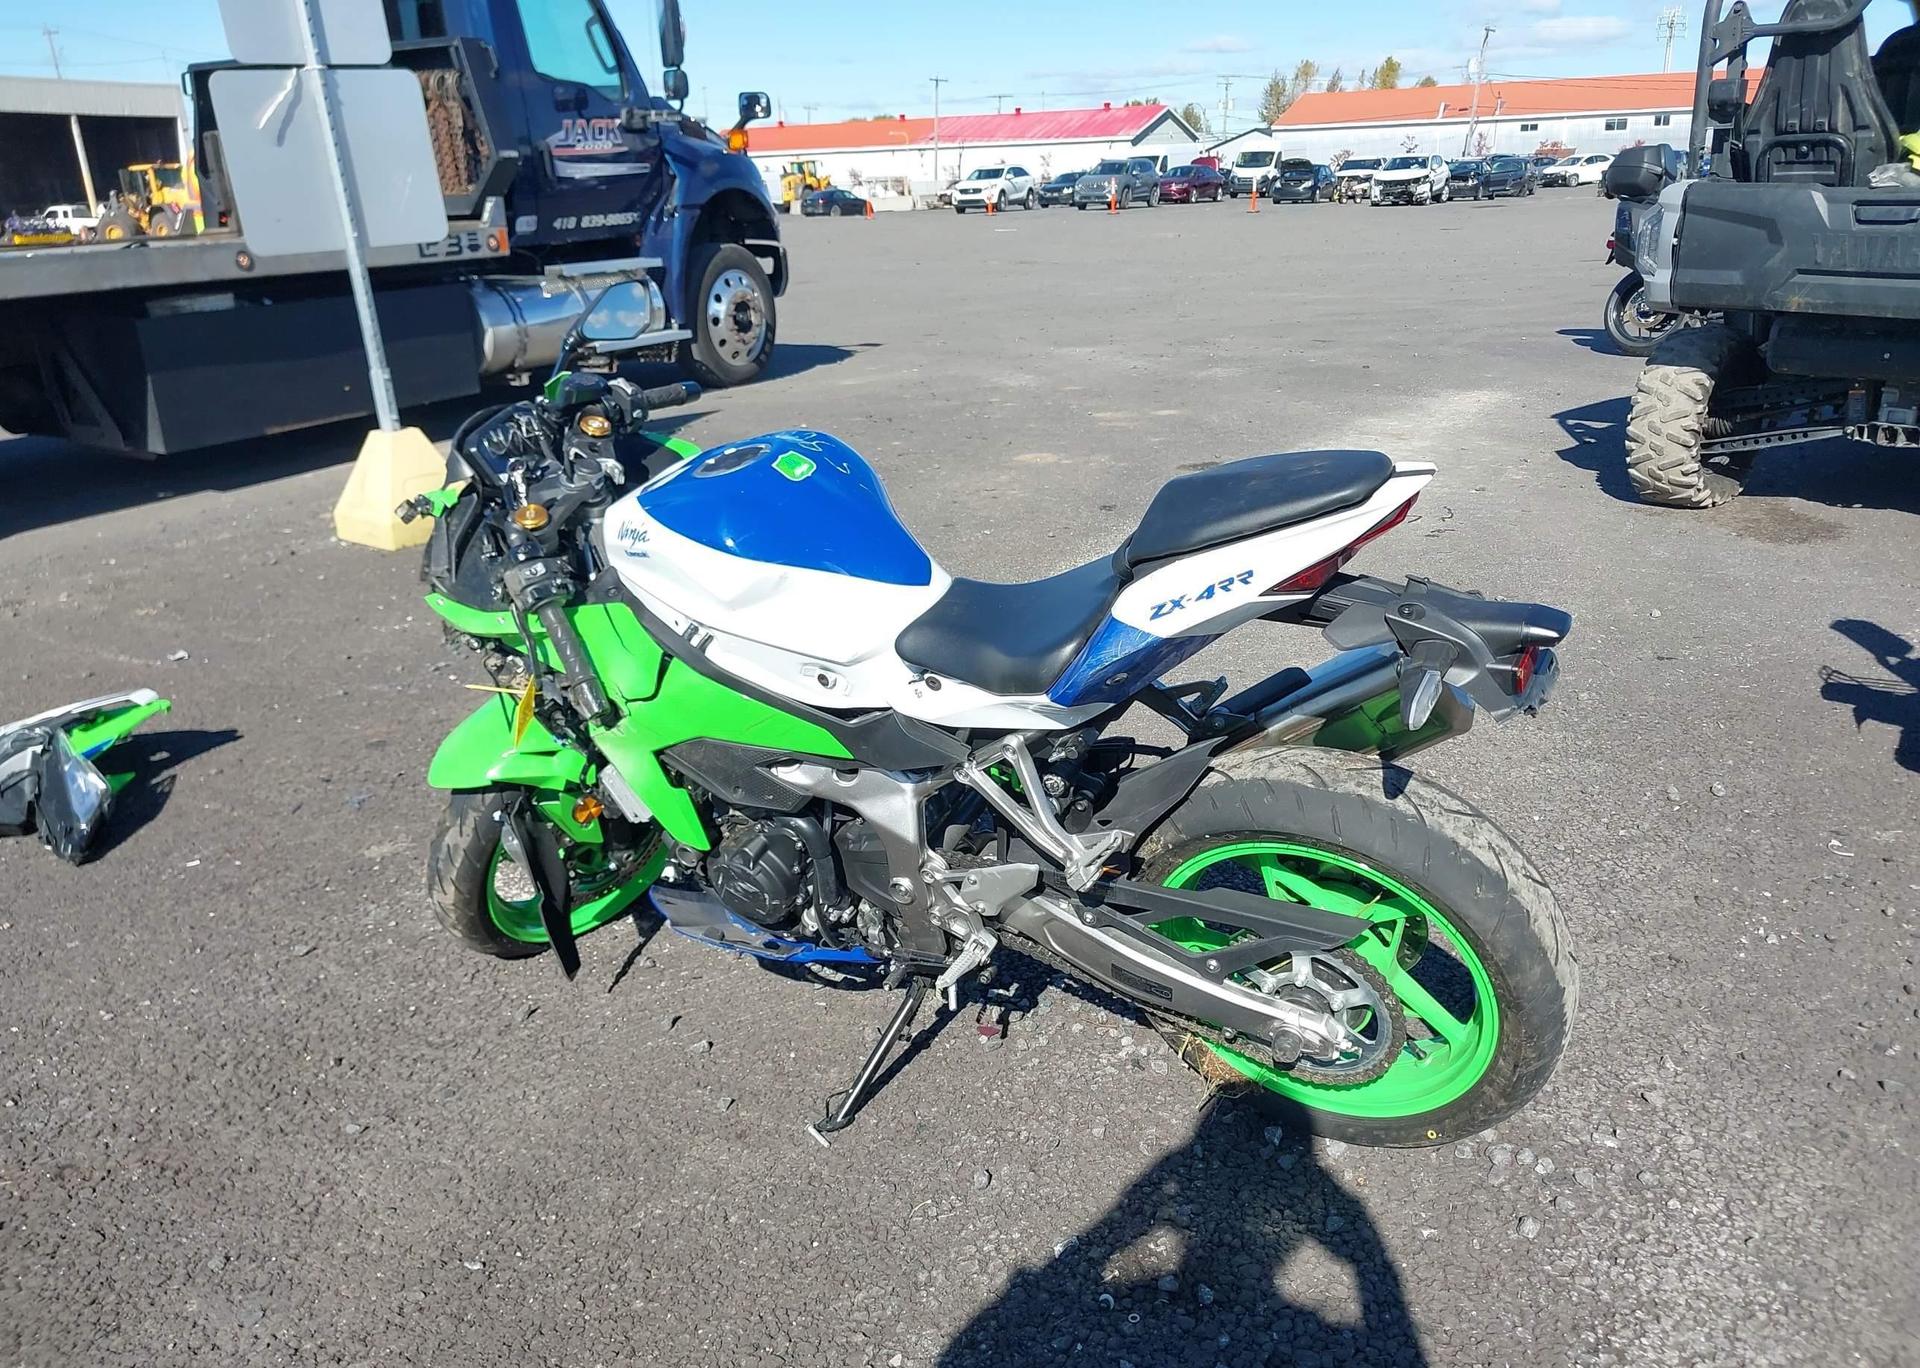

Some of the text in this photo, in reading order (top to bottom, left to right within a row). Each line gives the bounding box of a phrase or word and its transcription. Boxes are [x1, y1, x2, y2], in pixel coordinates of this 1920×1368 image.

[558, 118, 622, 144] JACK
[617, 519, 651, 550] Ninja
[1149, 569, 1254, 620] ZX-4RR
